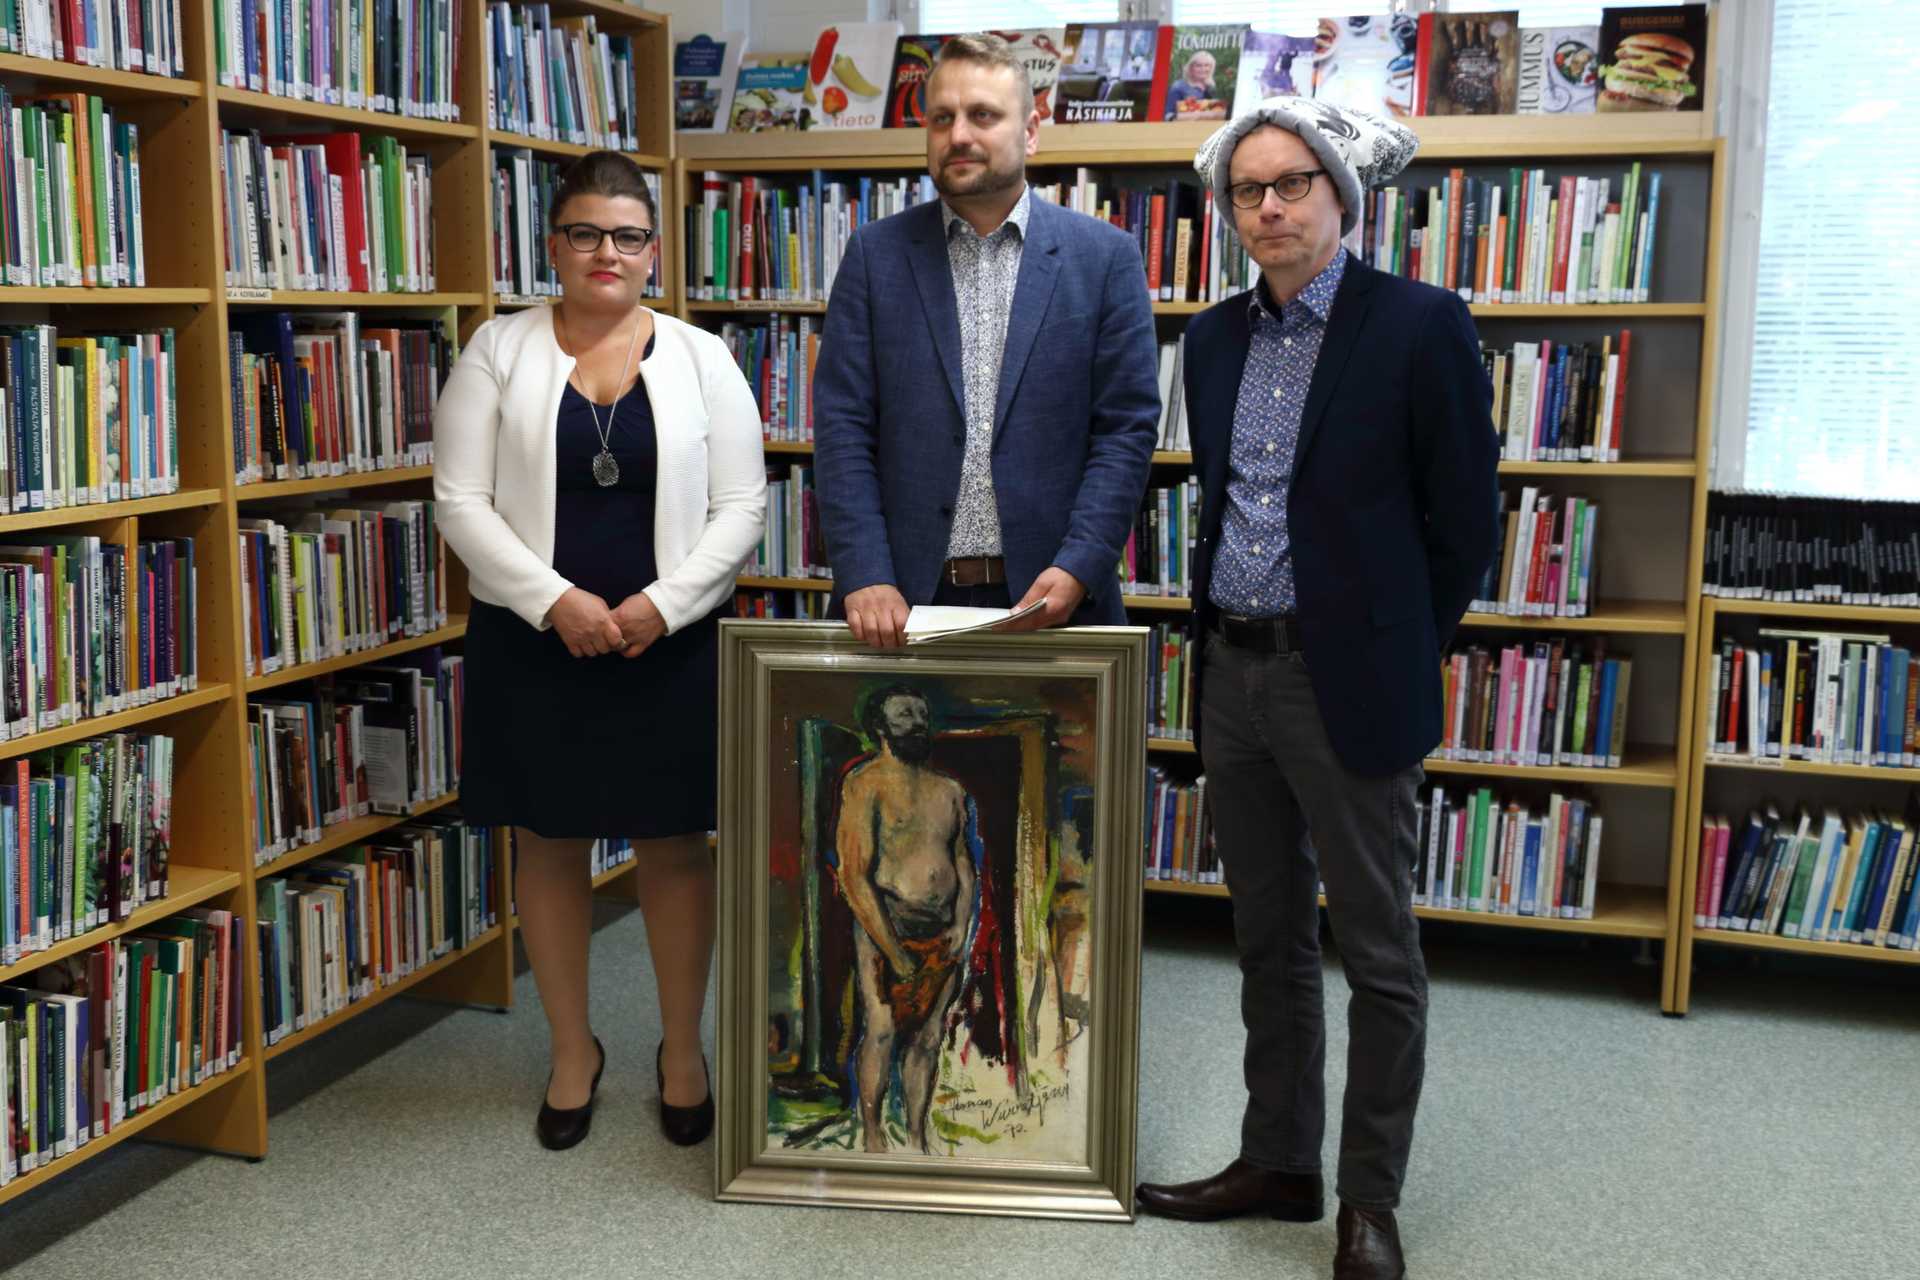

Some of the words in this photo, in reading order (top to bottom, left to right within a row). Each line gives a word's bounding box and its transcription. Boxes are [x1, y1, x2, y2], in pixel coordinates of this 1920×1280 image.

[1520, 33, 1544, 110] HUMMUS
[1066, 107, 1133, 121] KÄSIKIRJA
[742, 223, 751, 254] OLUT
